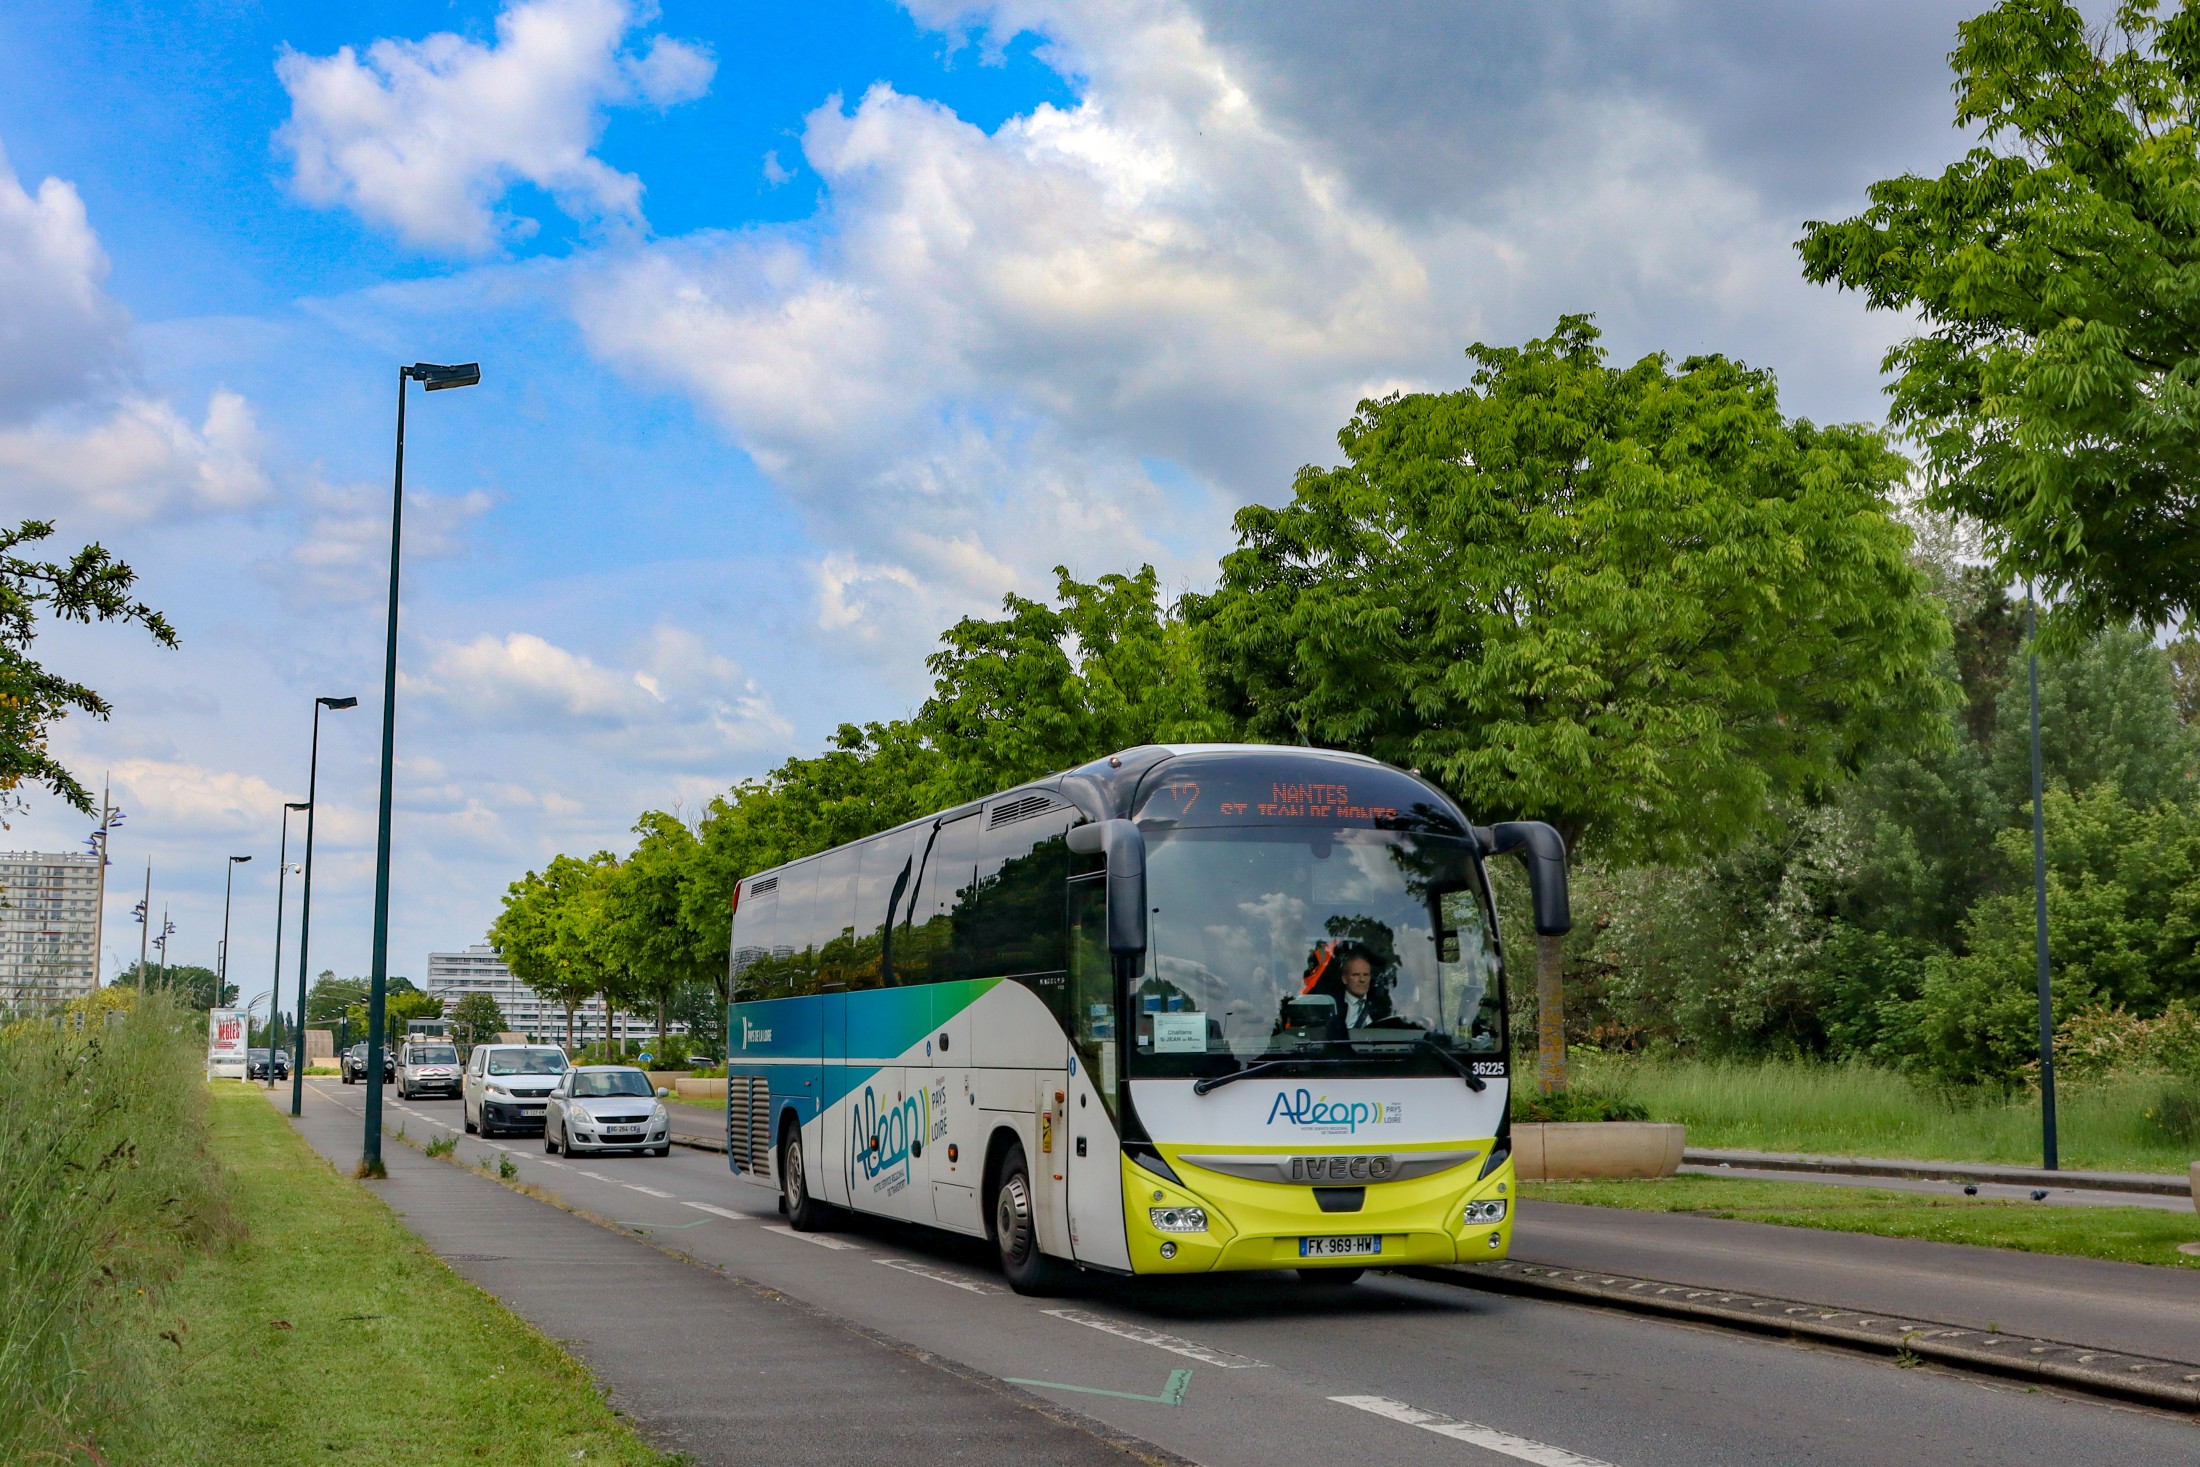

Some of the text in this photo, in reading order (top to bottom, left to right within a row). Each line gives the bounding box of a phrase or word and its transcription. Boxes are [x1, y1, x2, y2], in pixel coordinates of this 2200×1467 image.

[1272, 783, 1349, 805] NANTES
[1472, 1062, 1505, 1075] 36225
[931, 1086, 946, 1110] PAYS
[1266, 1088, 1369, 1134] Aléop
[851, 1086, 919, 1190] Aléop
[931, 1117, 947, 1141] LOIRE
[1292, 1156, 1392, 1180] IVECO
[1309, 1238, 1372, 1254] FK-969-HW
